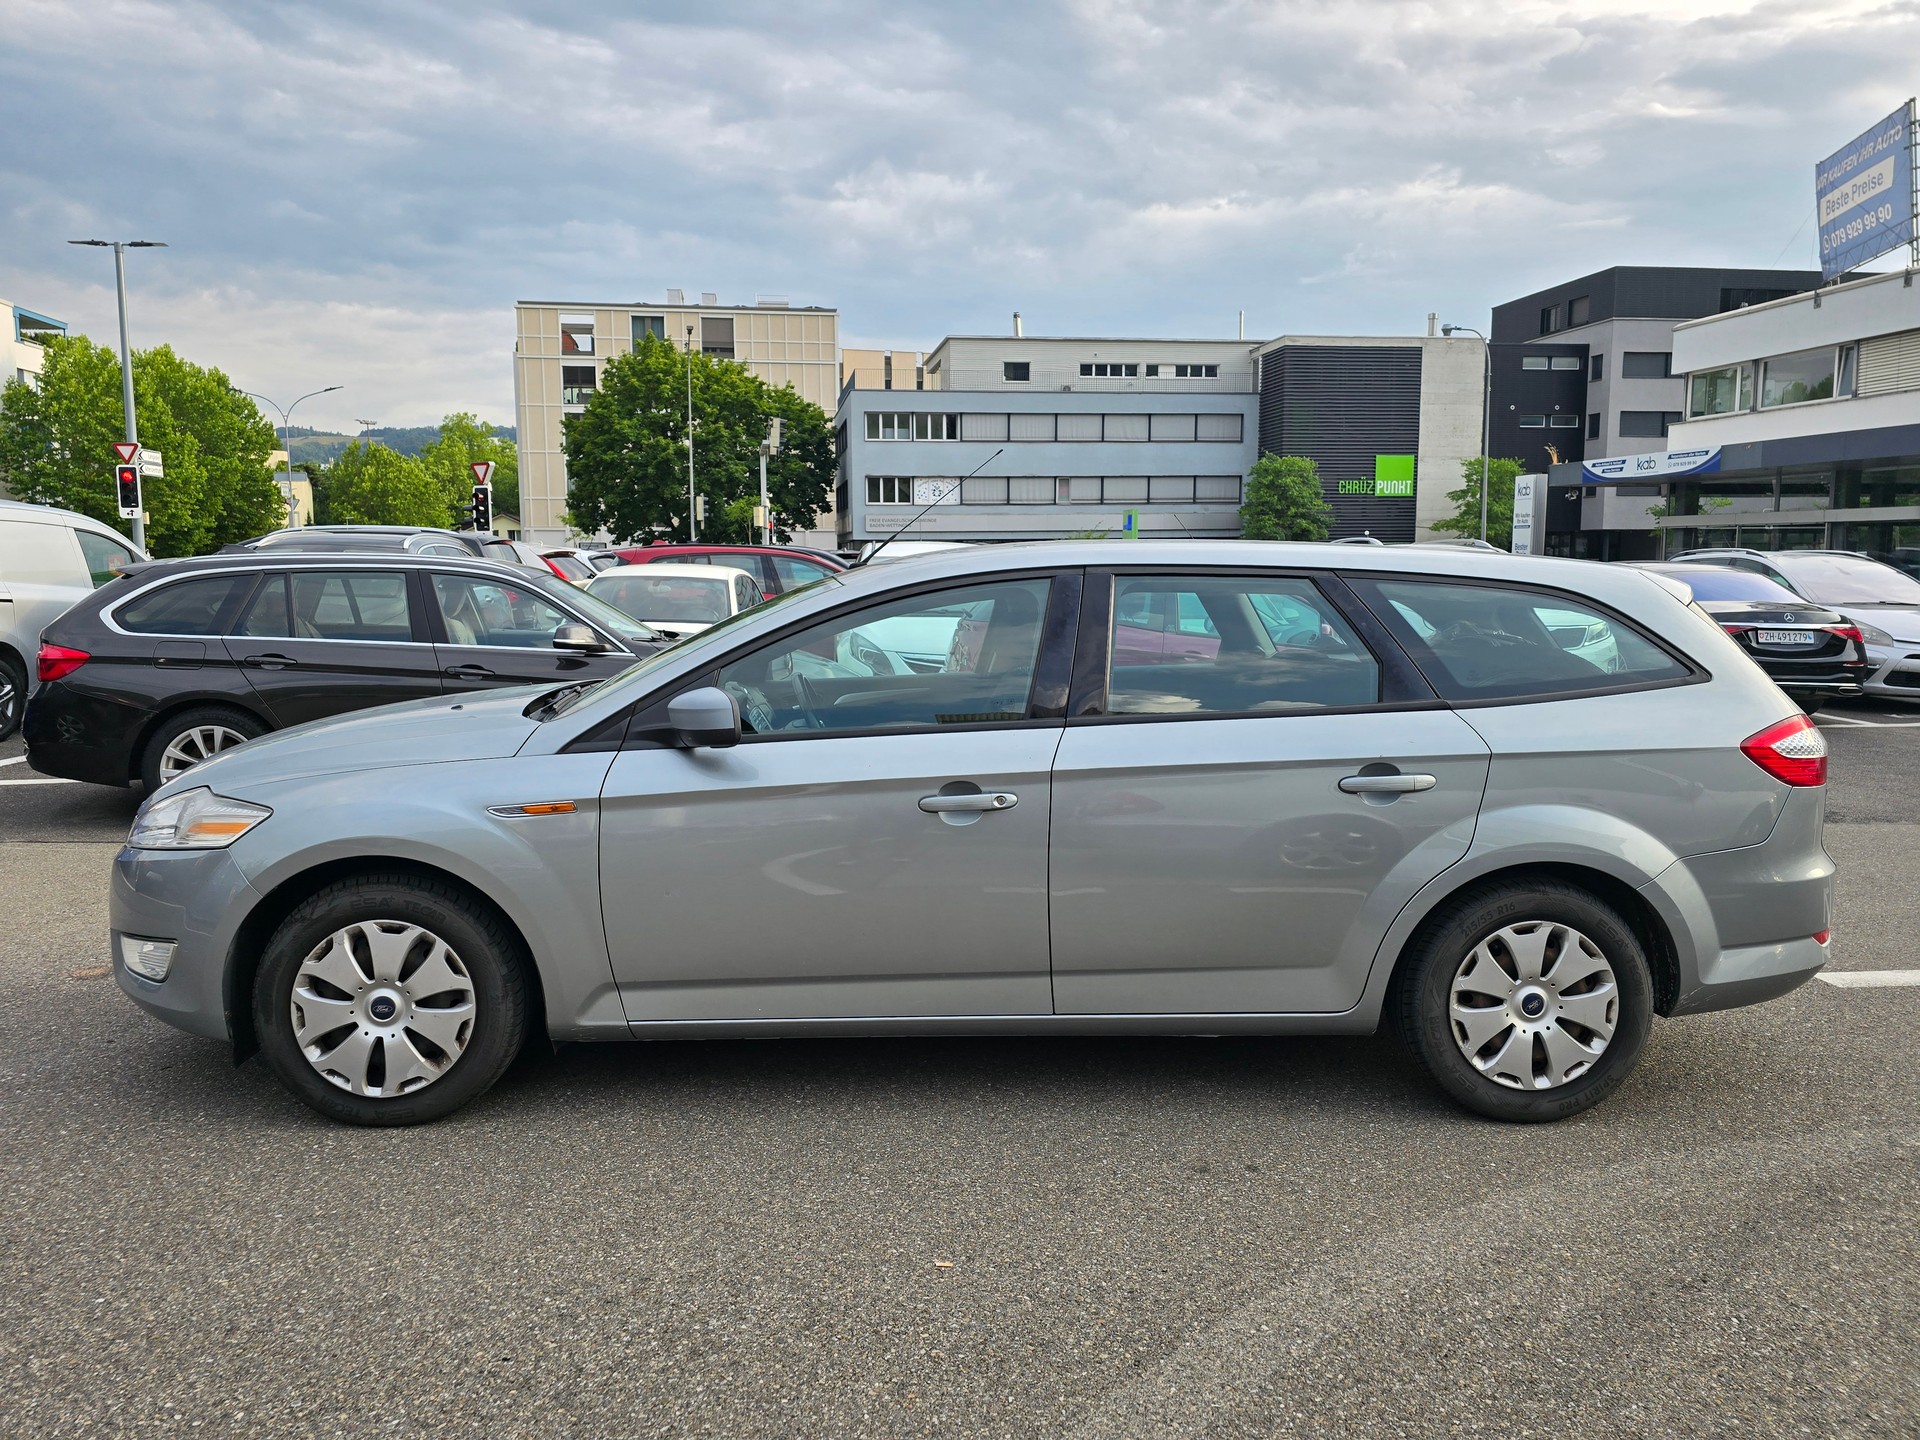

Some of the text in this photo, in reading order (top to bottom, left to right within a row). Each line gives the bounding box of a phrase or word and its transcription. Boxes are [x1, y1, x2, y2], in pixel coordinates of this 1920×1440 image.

[1827, 152, 1859, 182] KAUFEN
[1859, 142, 1875, 162] IHR
[1874, 125, 1903, 150] AUTO
[1826, 171, 1884, 216] Beste Preise
[1831, 203, 1892, 248] 079 929 99 90
[1637, 456, 1657, 471] kab
[1517, 483, 1531, 497] kab
[1514, 543, 1528, 551] Bester
[403, 899, 447, 924] TECAR
[1461, 902, 1515, 939] 215/55 R16
[1559, 1074, 1614, 1112] SPIRIT PRO
